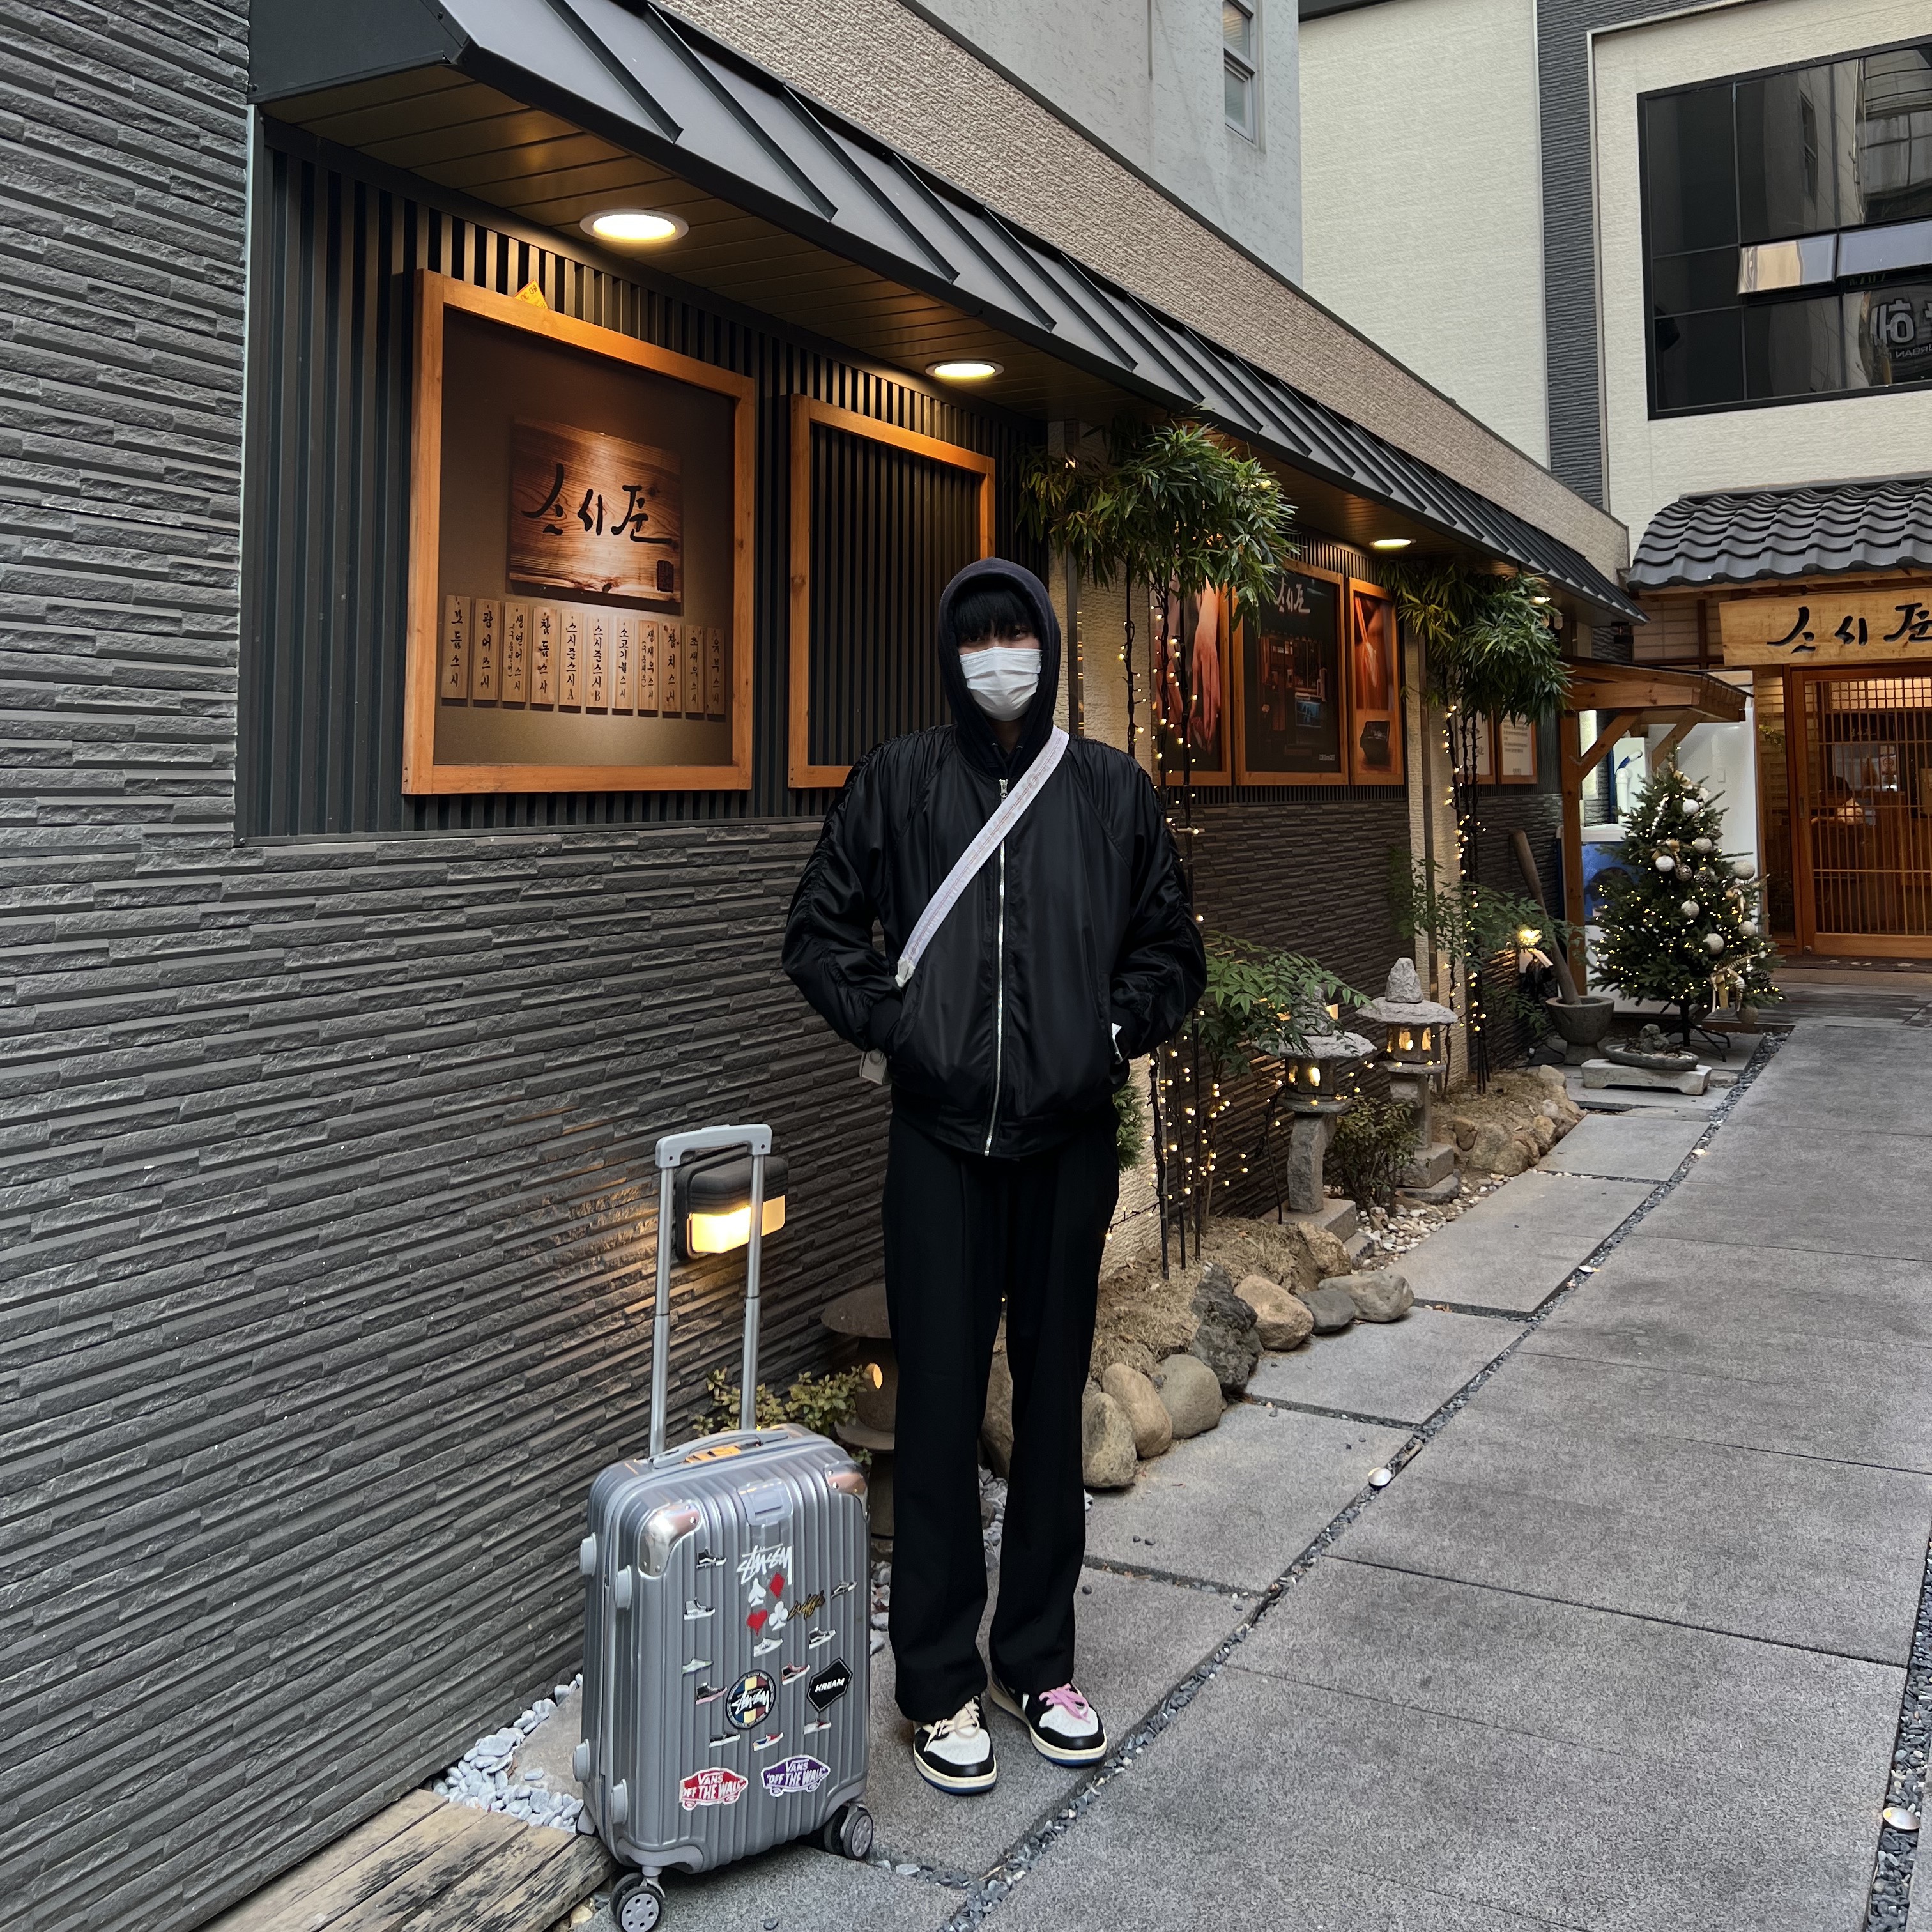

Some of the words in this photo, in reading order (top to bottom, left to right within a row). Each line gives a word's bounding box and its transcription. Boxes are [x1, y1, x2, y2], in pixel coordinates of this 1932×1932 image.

[815, 1678, 845, 1692] KREAM
[785, 1772, 802, 1787] THE
[698, 1784, 717, 1800] THE
